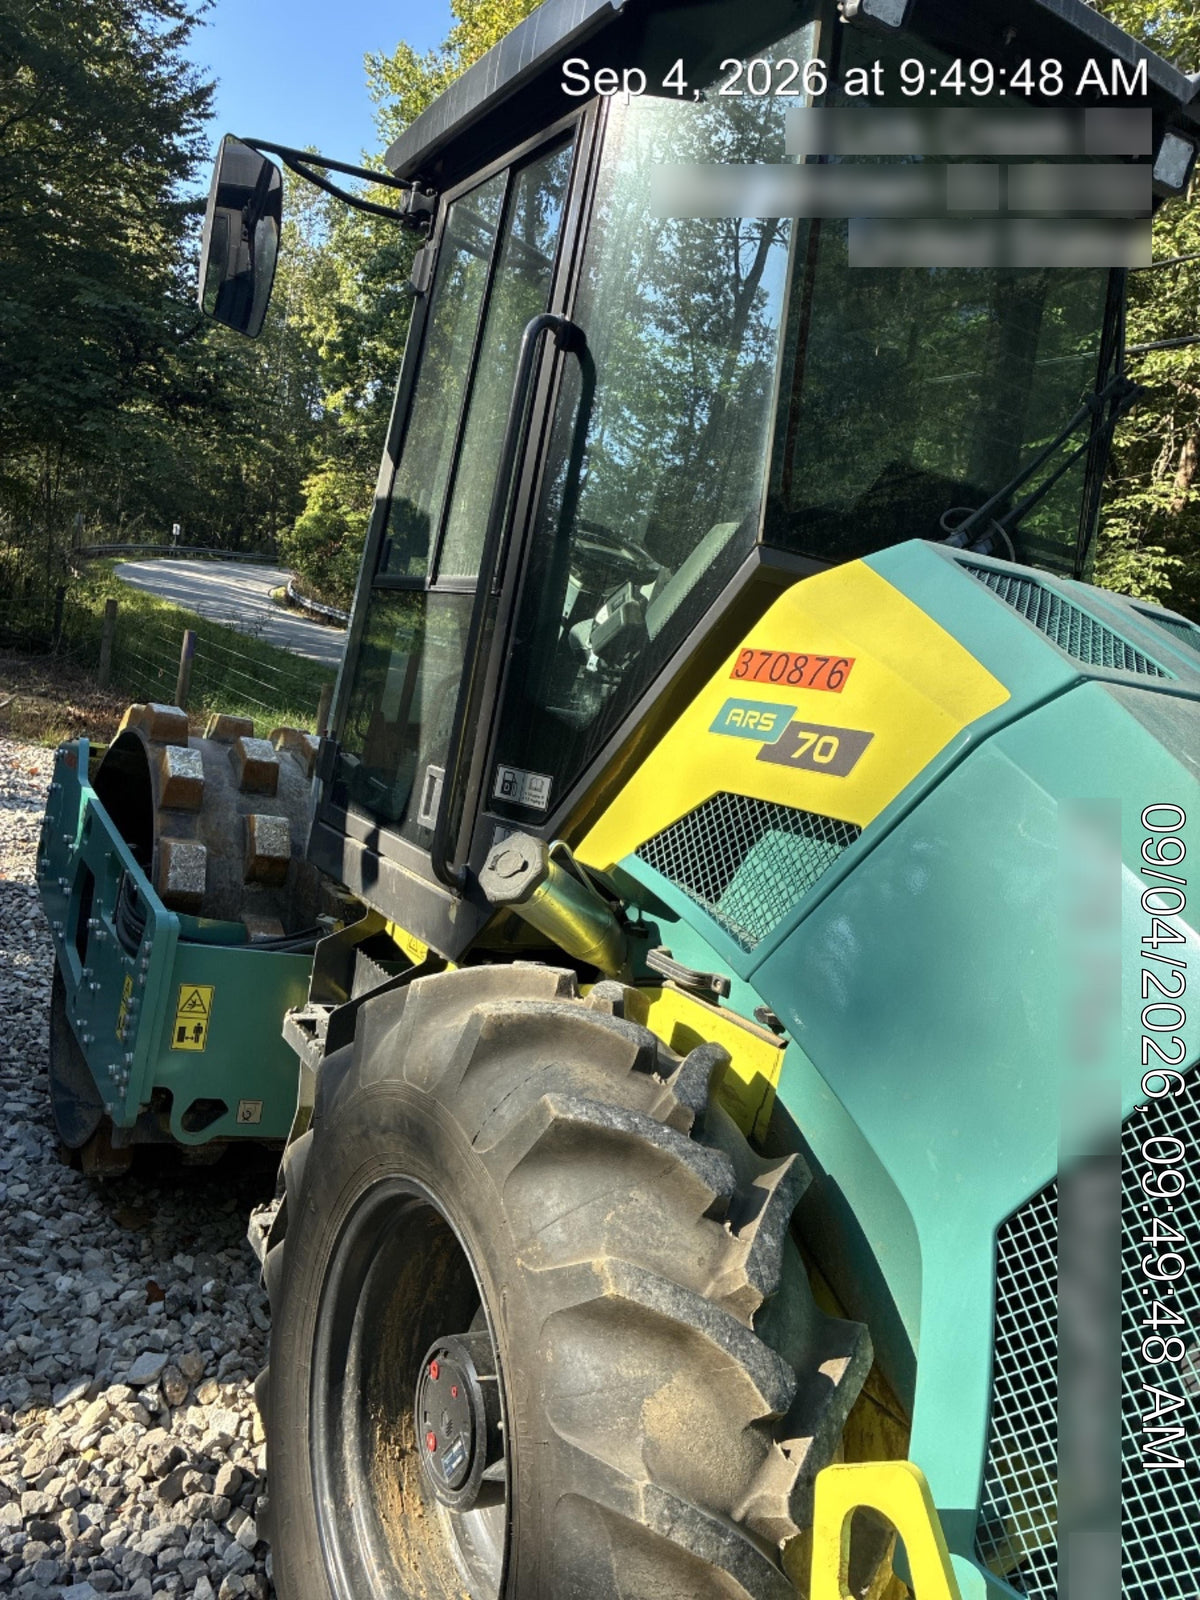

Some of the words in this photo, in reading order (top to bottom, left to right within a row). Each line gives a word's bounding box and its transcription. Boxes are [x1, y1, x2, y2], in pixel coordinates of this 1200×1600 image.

[735, 650, 849, 690] 370876
[725, 708, 778, 732] ARS
[790, 731, 840, 764] 70
